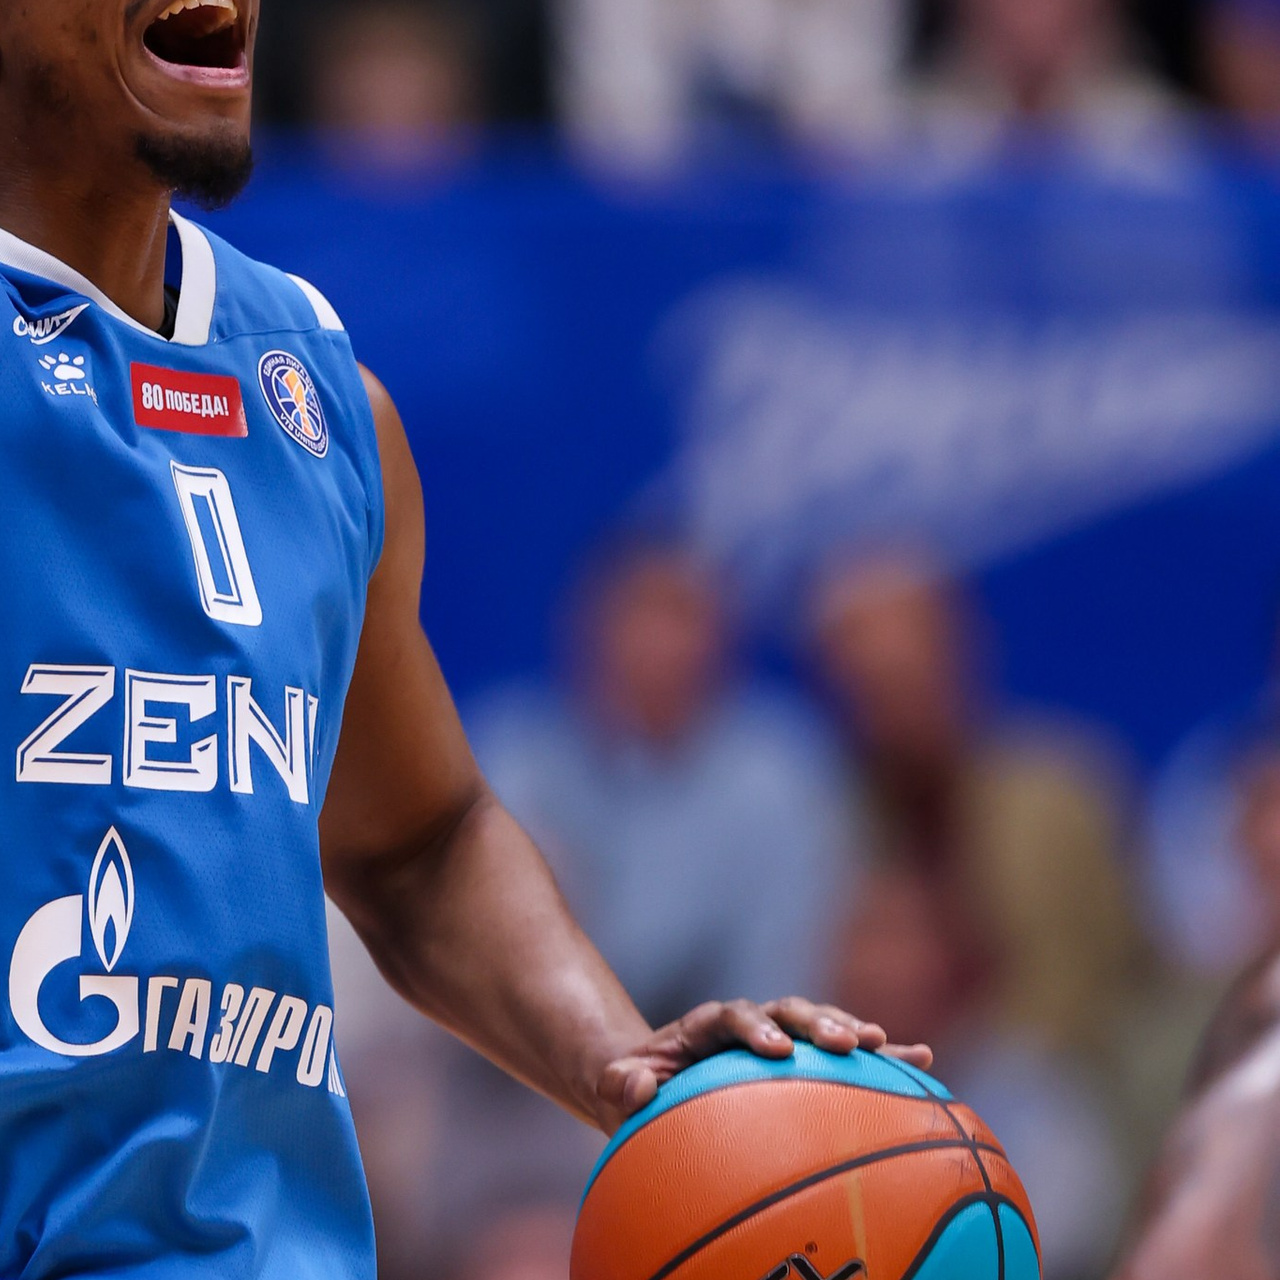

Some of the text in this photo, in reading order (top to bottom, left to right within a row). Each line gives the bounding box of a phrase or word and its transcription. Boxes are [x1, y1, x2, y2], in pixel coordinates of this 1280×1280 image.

[141, 382, 230, 418] 80 ПОБЕДА!
[280, 413, 295, 432] VTB
[169, 459, 263, 627] 0
